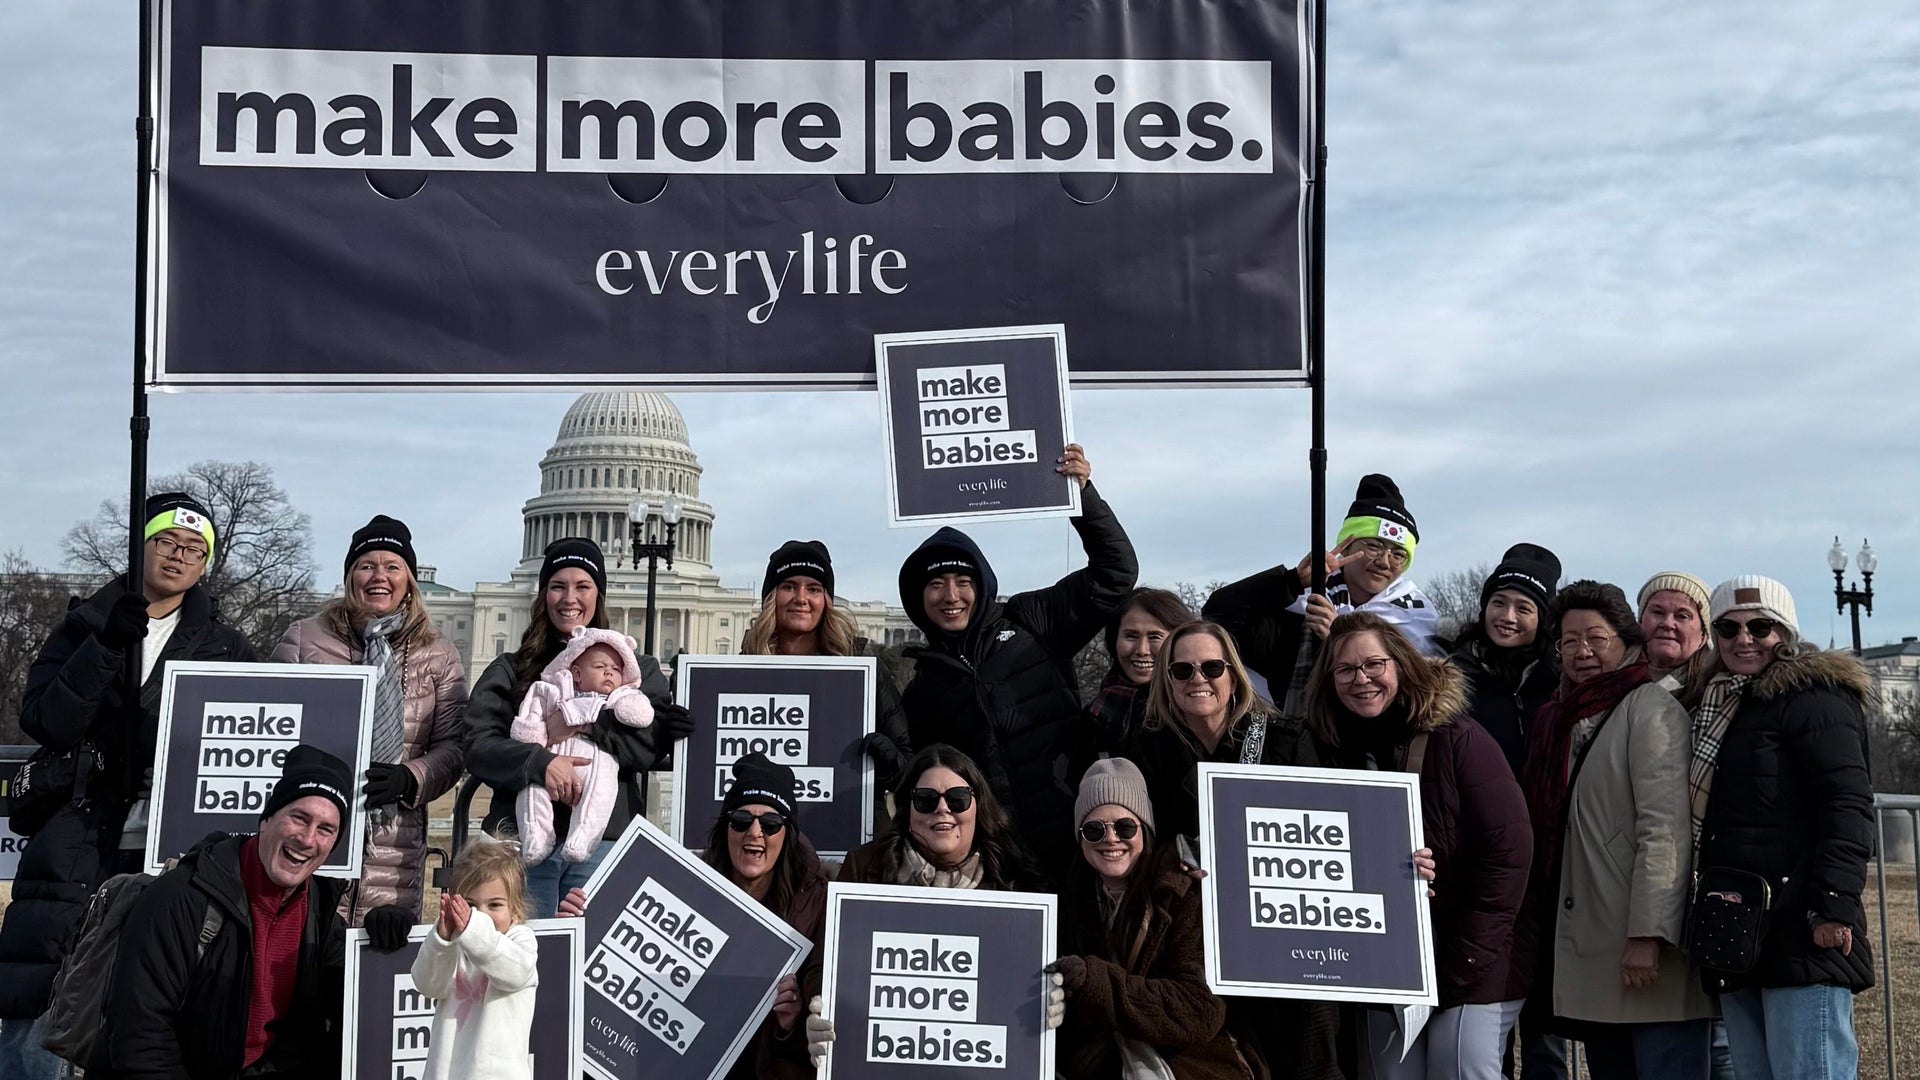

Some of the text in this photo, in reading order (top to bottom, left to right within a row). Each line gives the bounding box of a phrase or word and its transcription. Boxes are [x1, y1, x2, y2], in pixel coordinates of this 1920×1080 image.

[216, 63, 1264, 163] make more babies.
[595, 230, 909, 325] everylife
[921, 368, 1002, 398] make
[923, 405, 1003, 428] more
[925, 436, 1035, 466] babies.
[958, 478, 1008, 495] everylife
[206, 706, 296, 736] make
[721, 697, 805, 726] make
[202, 747, 288, 768] more
[719, 737, 802, 758] more
[198, 780, 274, 811] babi
[718, 768, 831, 799] bes.
[1250, 813, 1345, 847] make
[1252, 856, 1345, 882] more
[632, 890, 714, 960] make
[1254, 891, 1383, 930] babies.
[610, 920, 692, 988] more
[875, 938, 973, 974] make
[1291, 946, 1350, 966] everylife
[584, 950, 686, 1050] babies.
[873, 984, 970, 1012] more
[590, 1016, 640, 1057] everylife
[871, 1023, 1004, 1064] babies.
